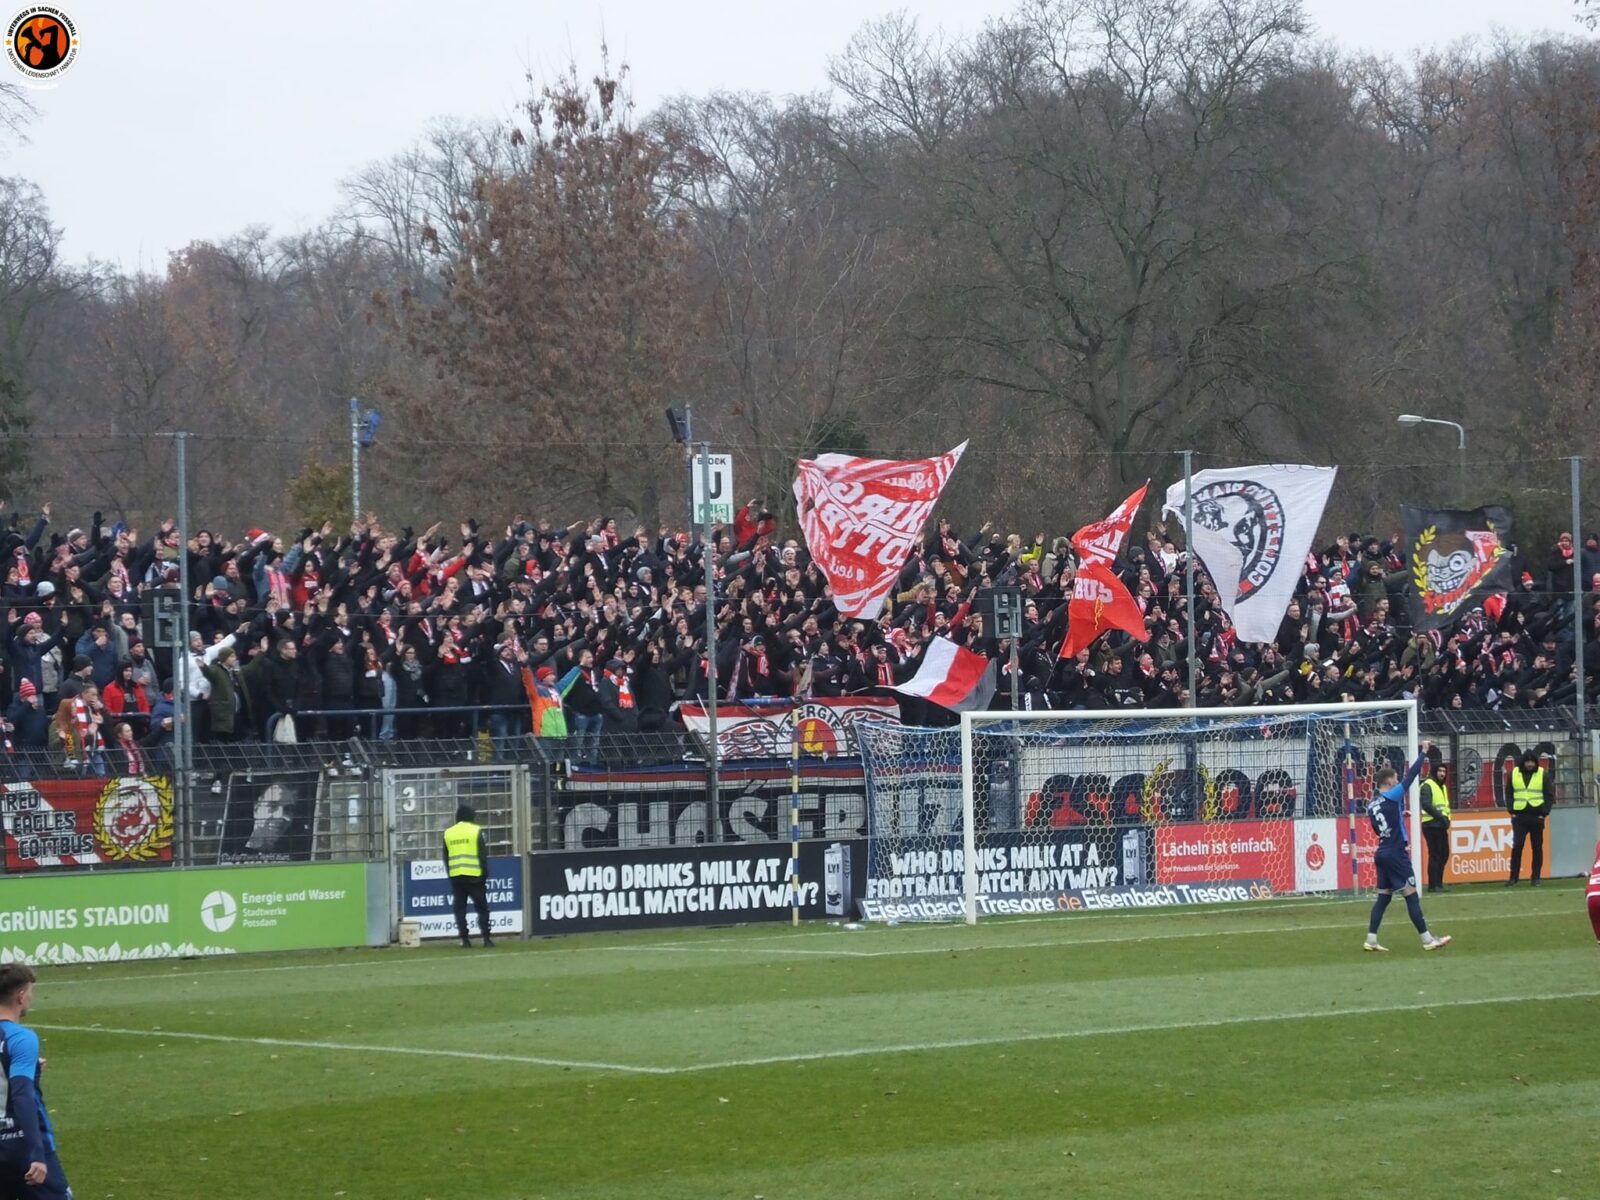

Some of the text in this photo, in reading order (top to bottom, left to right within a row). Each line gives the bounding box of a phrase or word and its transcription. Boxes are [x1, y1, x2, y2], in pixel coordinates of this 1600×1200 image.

[5, 790, 40, 813] RED
[402, 786, 416, 812] 3
[13, 811, 76, 836] EAGLES
[1372, 805, 1388, 832] 5
[19, 834, 94, 859] COTTBUS
[1162, 837, 1277, 857] Lächeln ist einfach.
[890, 843, 1099, 876] WHO DRNKS MILK AT A
[565, 866, 616, 892] WHO
[621, 863, 694, 891] DRINKS
[699, 860, 751, 885] MILK
[754, 859, 780, 882] AT
[867, 875, 959, 900] FOOTBALL
[1028, 867, 1118, 891] ANYWAY?
[241, 888, 346, 906] Energie und Wasser
[411, 896, 445, 908] DEINE
[539, 882, 819, 920] FOOTBALL MATCH ANYWAY?
[1081, 880, 1273, 909] Eisenbach Tresore.de
[0, 903, 169, 933] GRÜNES STADION
[242, 907, 287, 917] Stadtwerke
[242, 918, 278, 928] Potsdam
